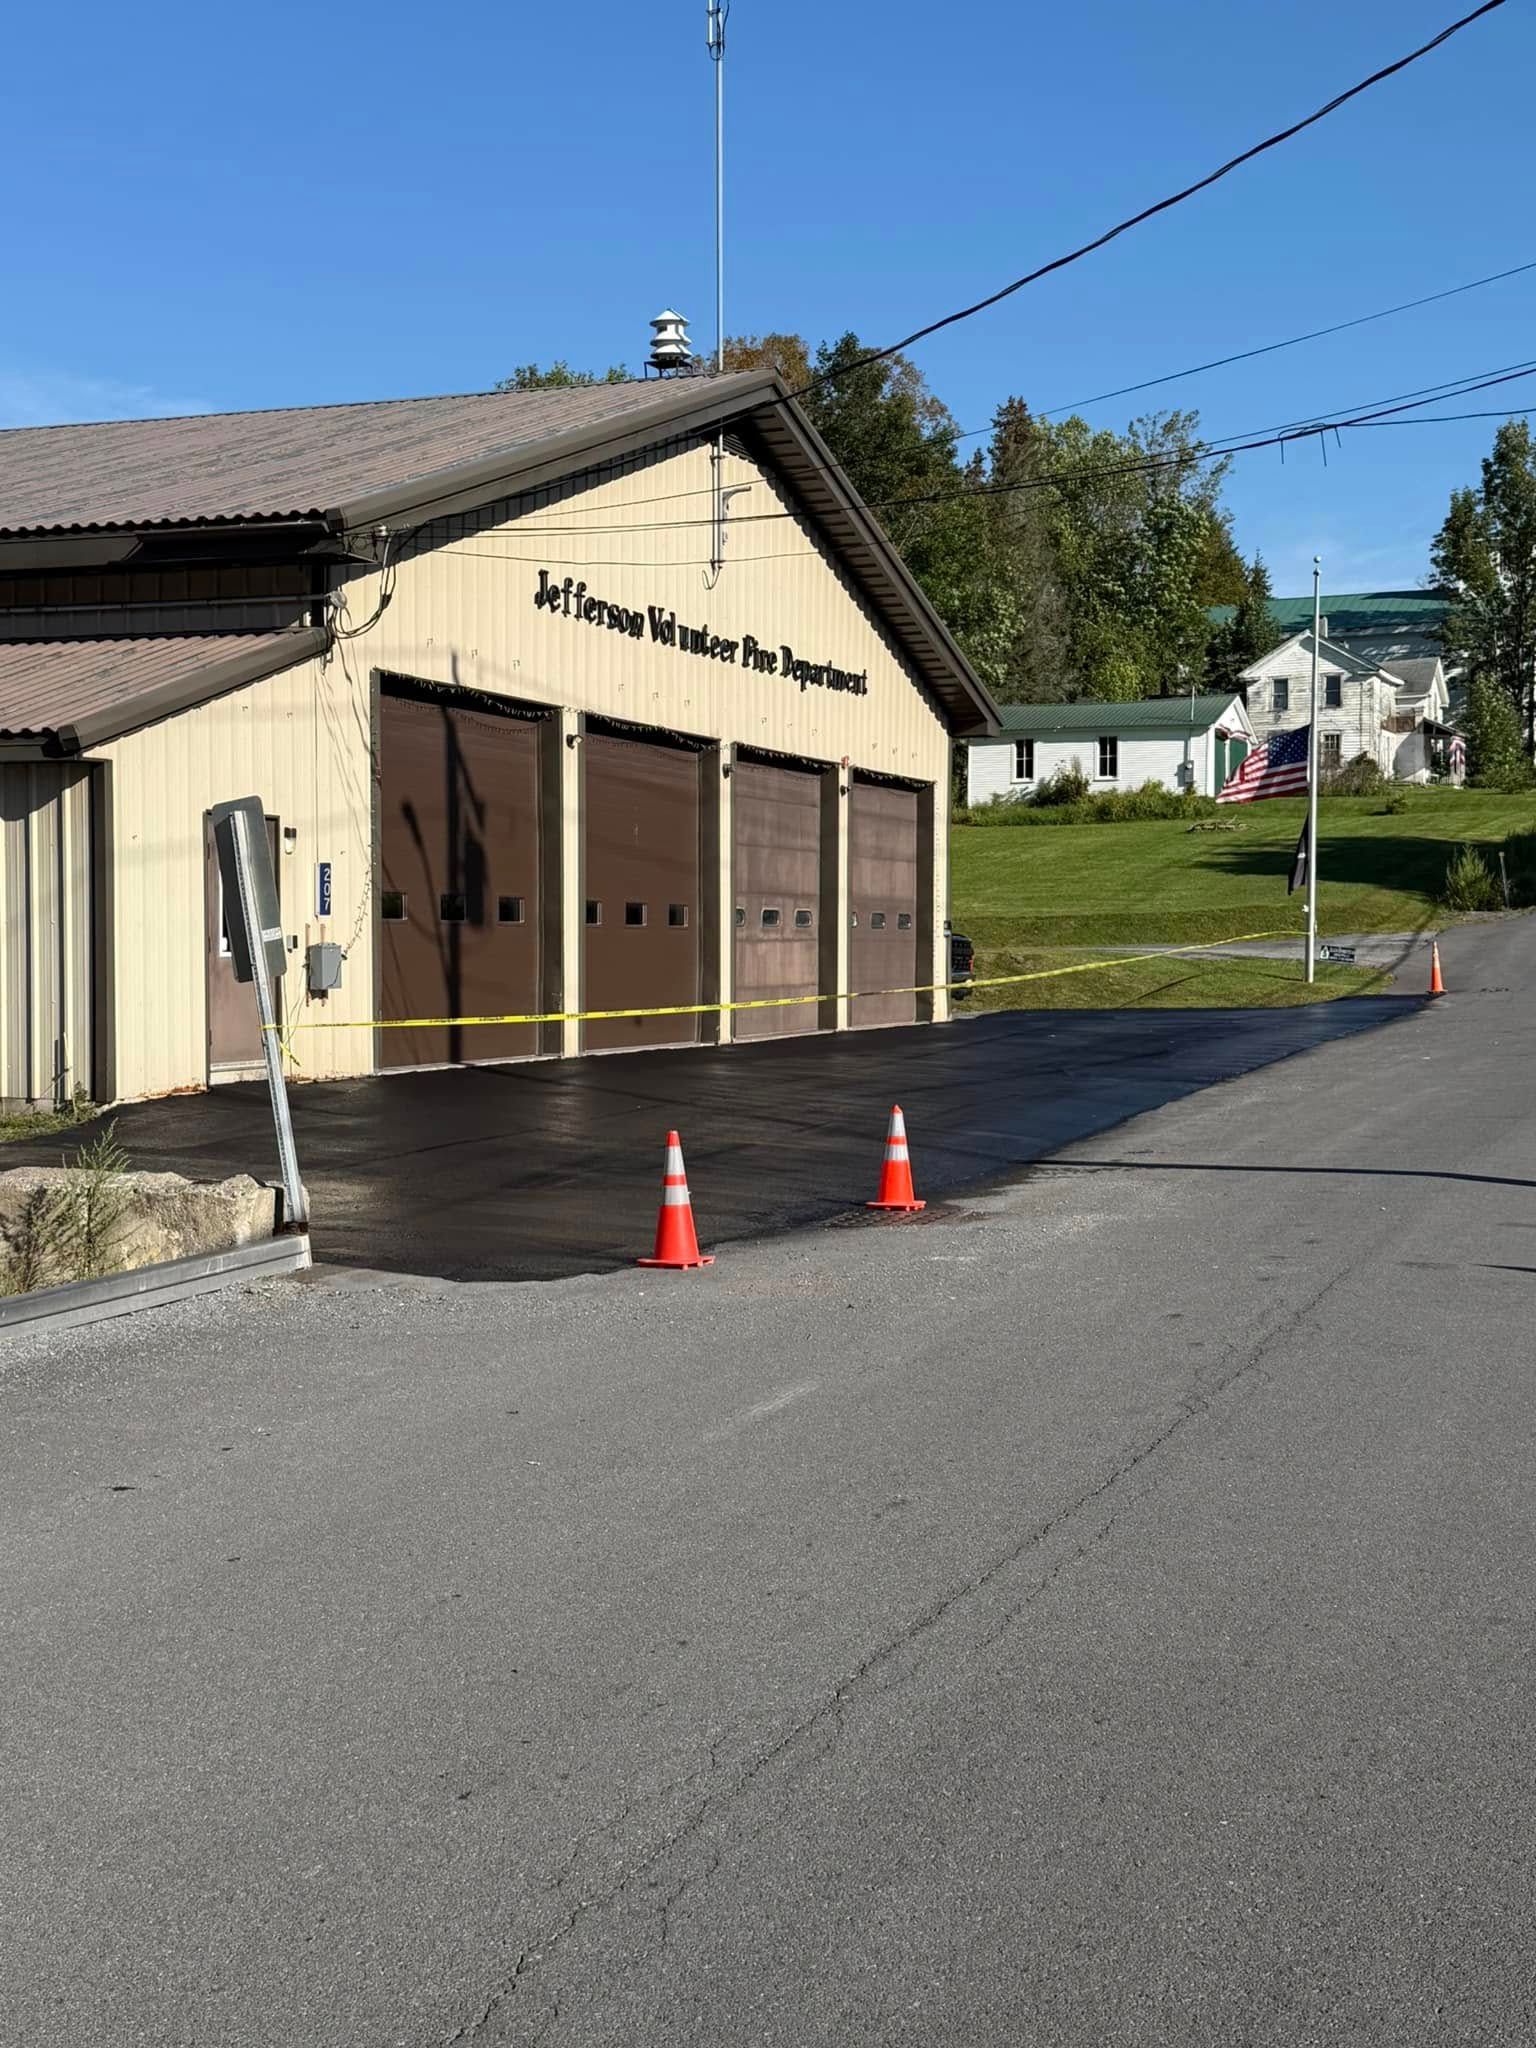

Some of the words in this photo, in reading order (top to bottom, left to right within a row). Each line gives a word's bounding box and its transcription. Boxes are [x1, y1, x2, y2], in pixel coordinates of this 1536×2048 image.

[535, 569, 645, 640] Jefferson
[648, 606, 739, 663] Volunteer
[742, 635, 778, 675] Fire
[780, 646, 868, 697] Department
[323, 867, 331, 911] 207
